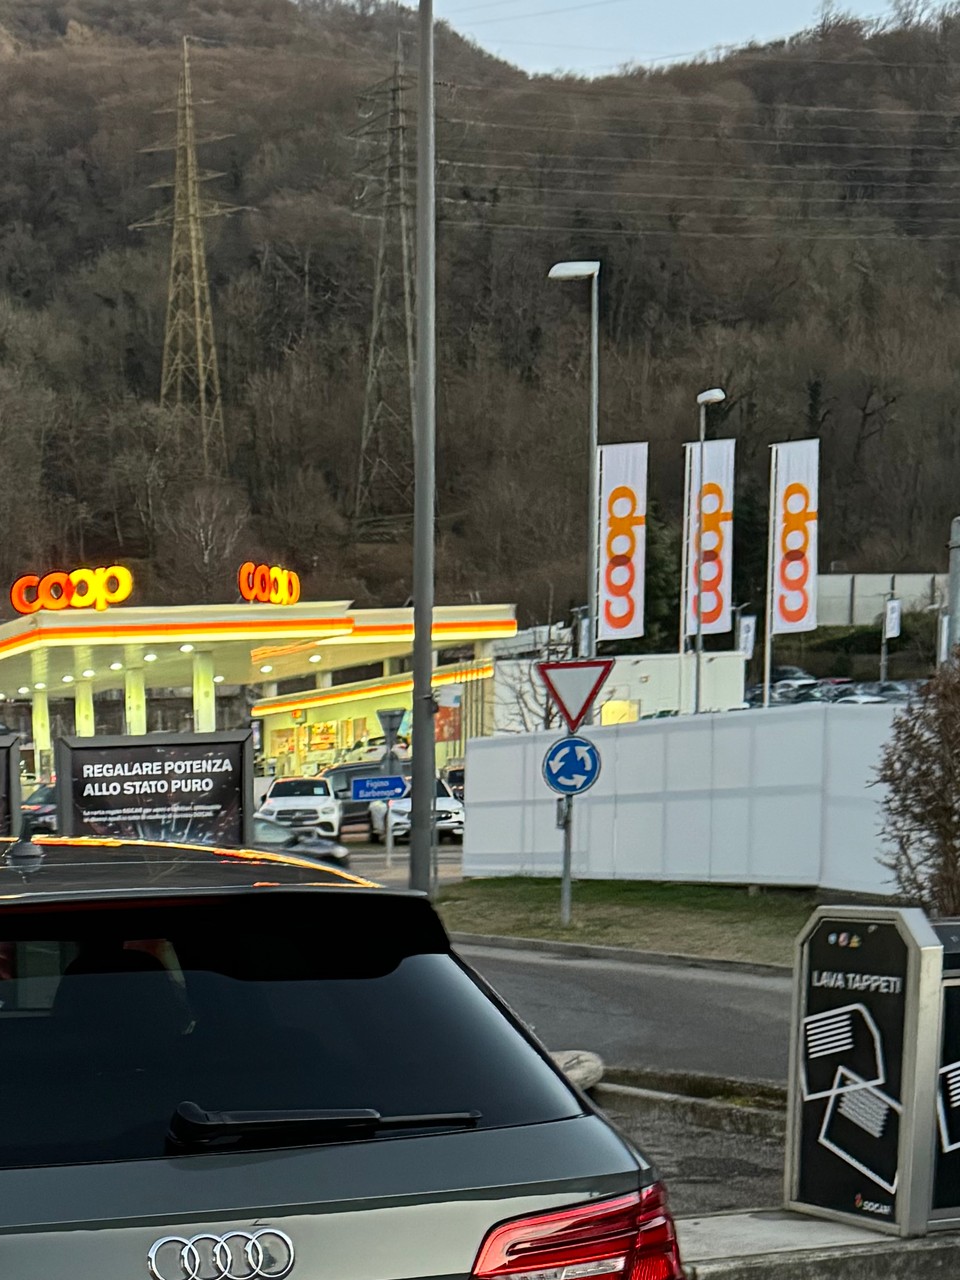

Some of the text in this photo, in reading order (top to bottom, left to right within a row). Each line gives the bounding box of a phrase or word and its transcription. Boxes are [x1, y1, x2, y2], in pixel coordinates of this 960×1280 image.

[604, 486, 646, 629] coop
[692, 482, 733, 624] coop
[778, 482, 818, 623] coop
[10, 565, 133, 614] coop
[239, 561, 300, 605] coop
[83, 759, 233, 778] REGALARE POTENZA
[83, 778, 214, 797] ALLO STATO PURO
[811, 970, 902, 993] LAVA TAPPETI
